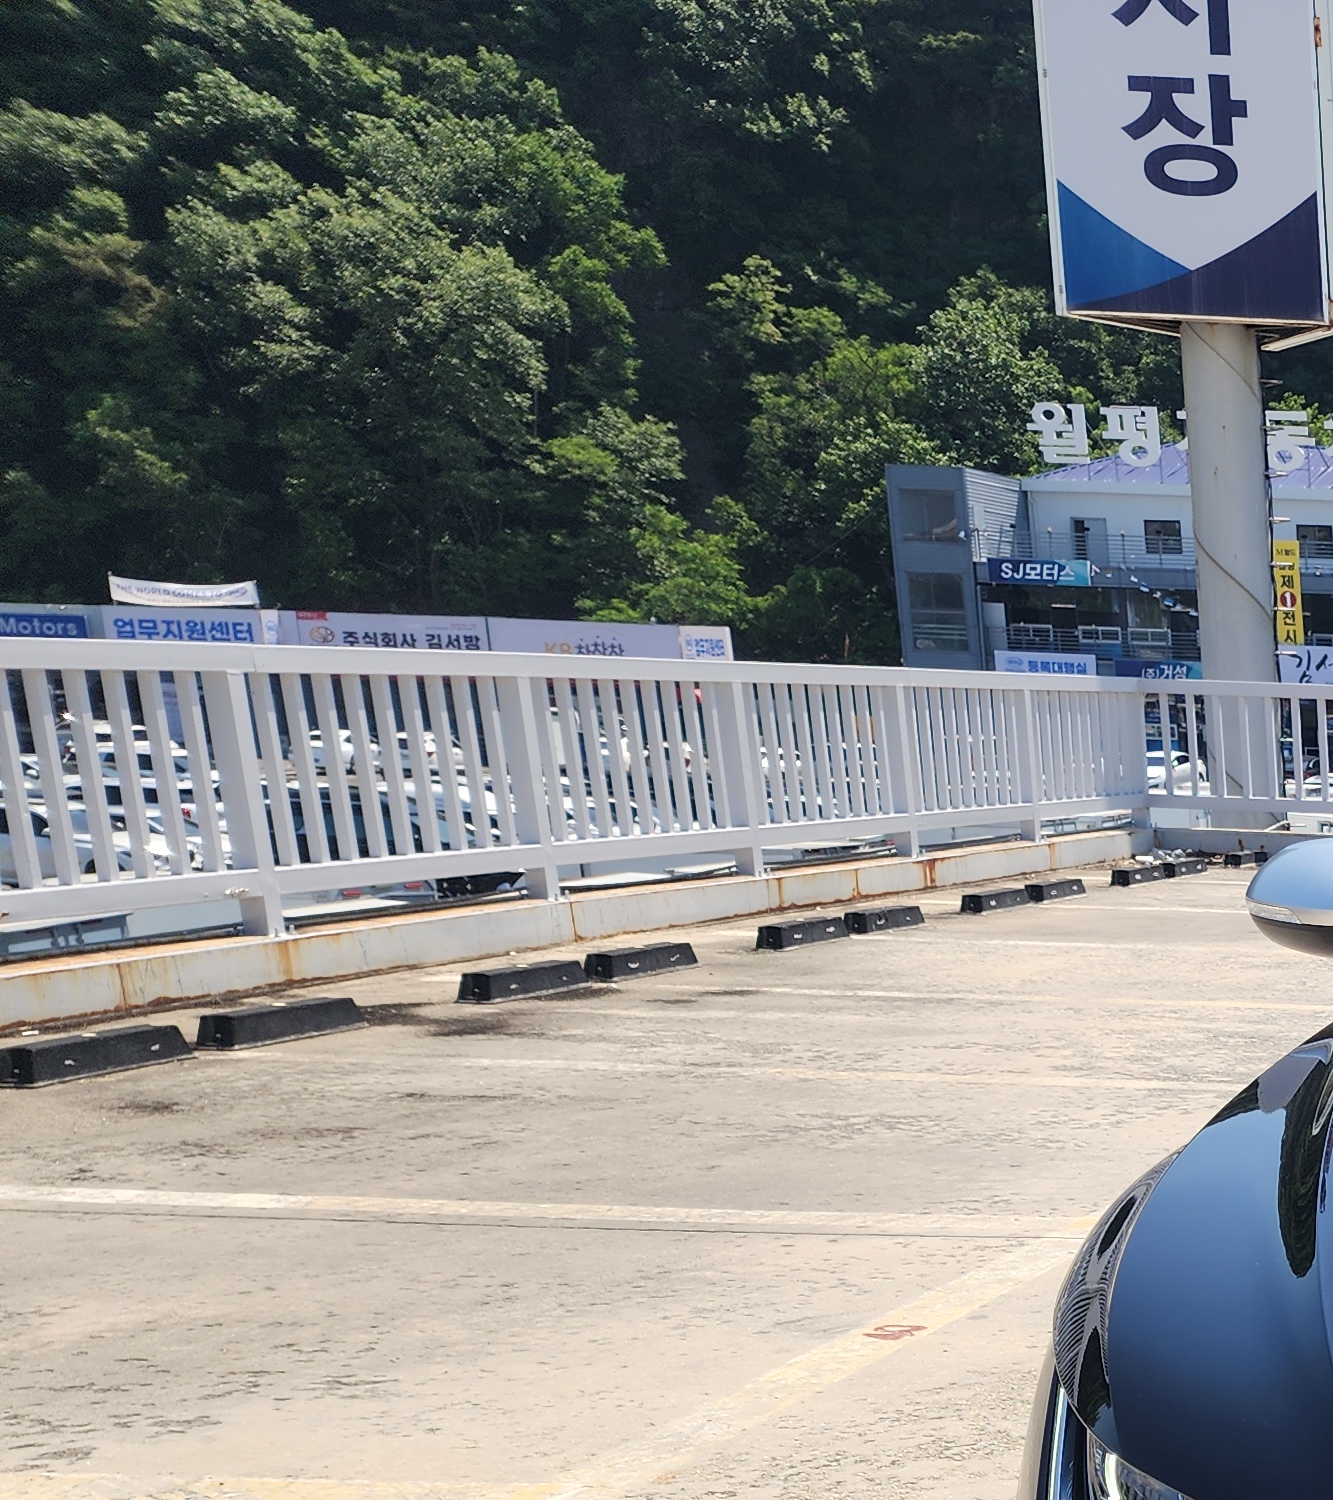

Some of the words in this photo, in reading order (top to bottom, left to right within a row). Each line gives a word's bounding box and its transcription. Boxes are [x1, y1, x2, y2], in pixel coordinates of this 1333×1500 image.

[1000, 562, 1075, 581] SJ모터스
[113, 617, 254, 642] 업무지원센터
[342, 631, 417, 649] 주식회사
